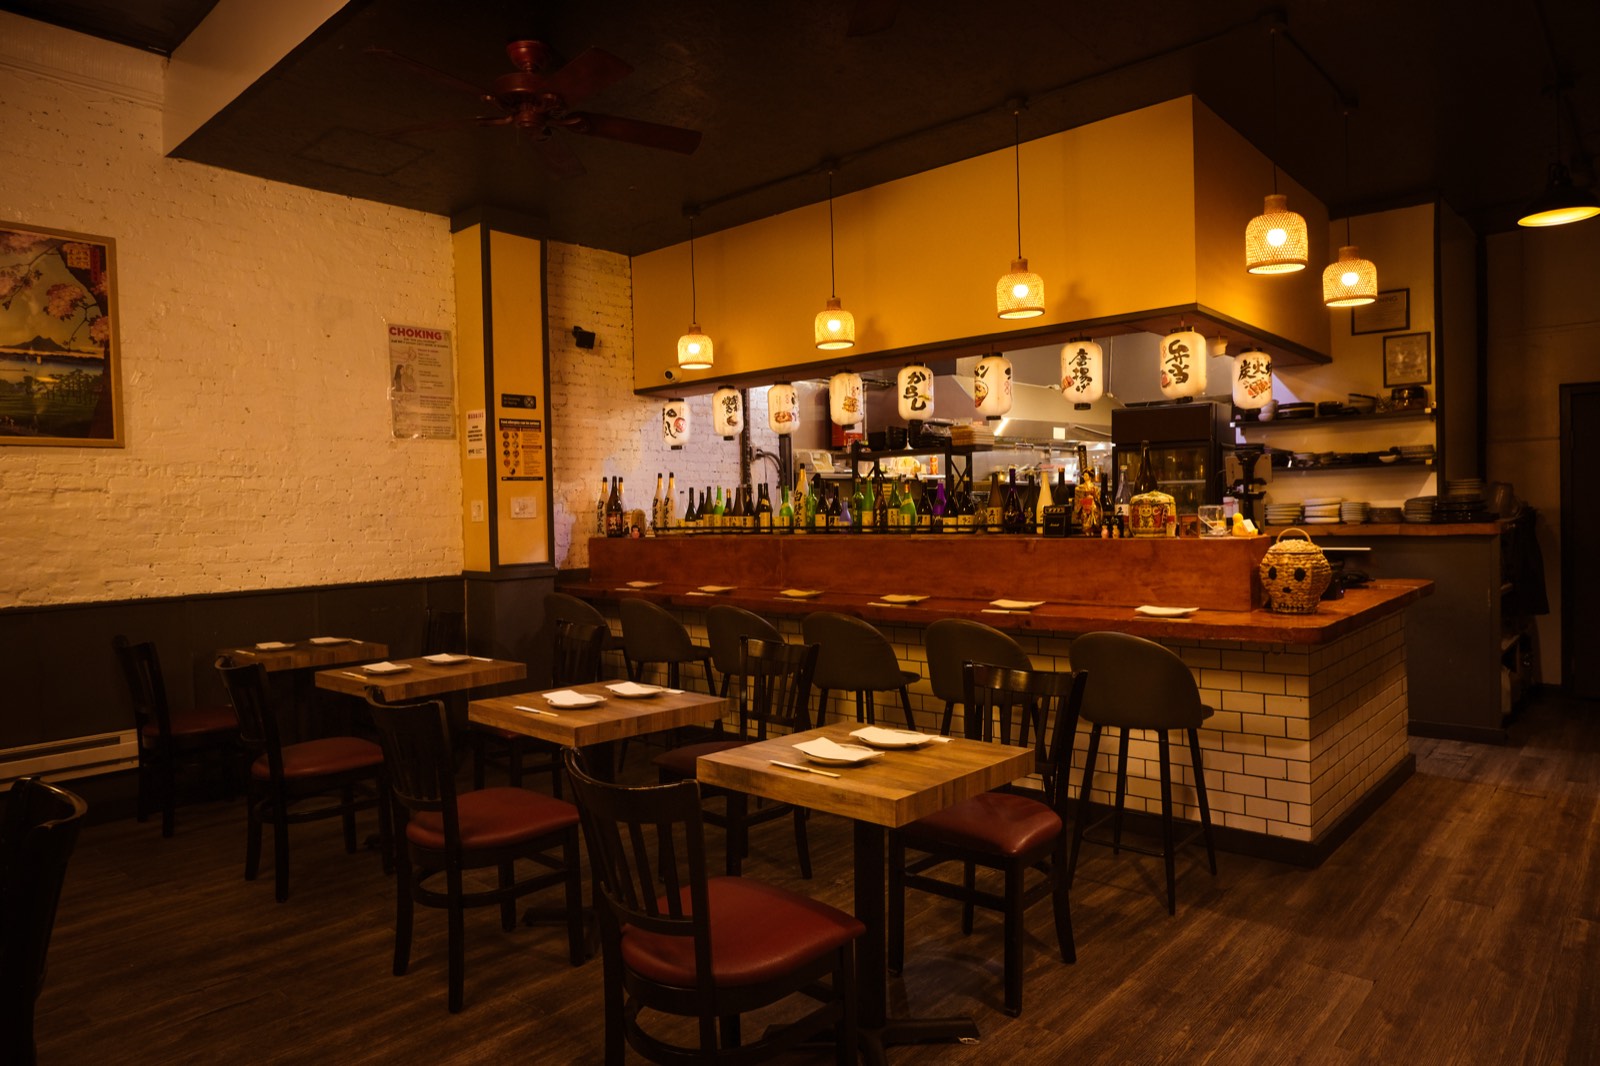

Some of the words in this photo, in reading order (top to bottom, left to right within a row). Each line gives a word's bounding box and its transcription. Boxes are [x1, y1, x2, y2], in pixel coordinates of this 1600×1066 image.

[389, 326, 442, 341] CHOKING
[1068, 348, 1093, 393] 唐揚げ
[1165, 339, 1190, 385] 弁当
[903, 371, 927, 411] からし
